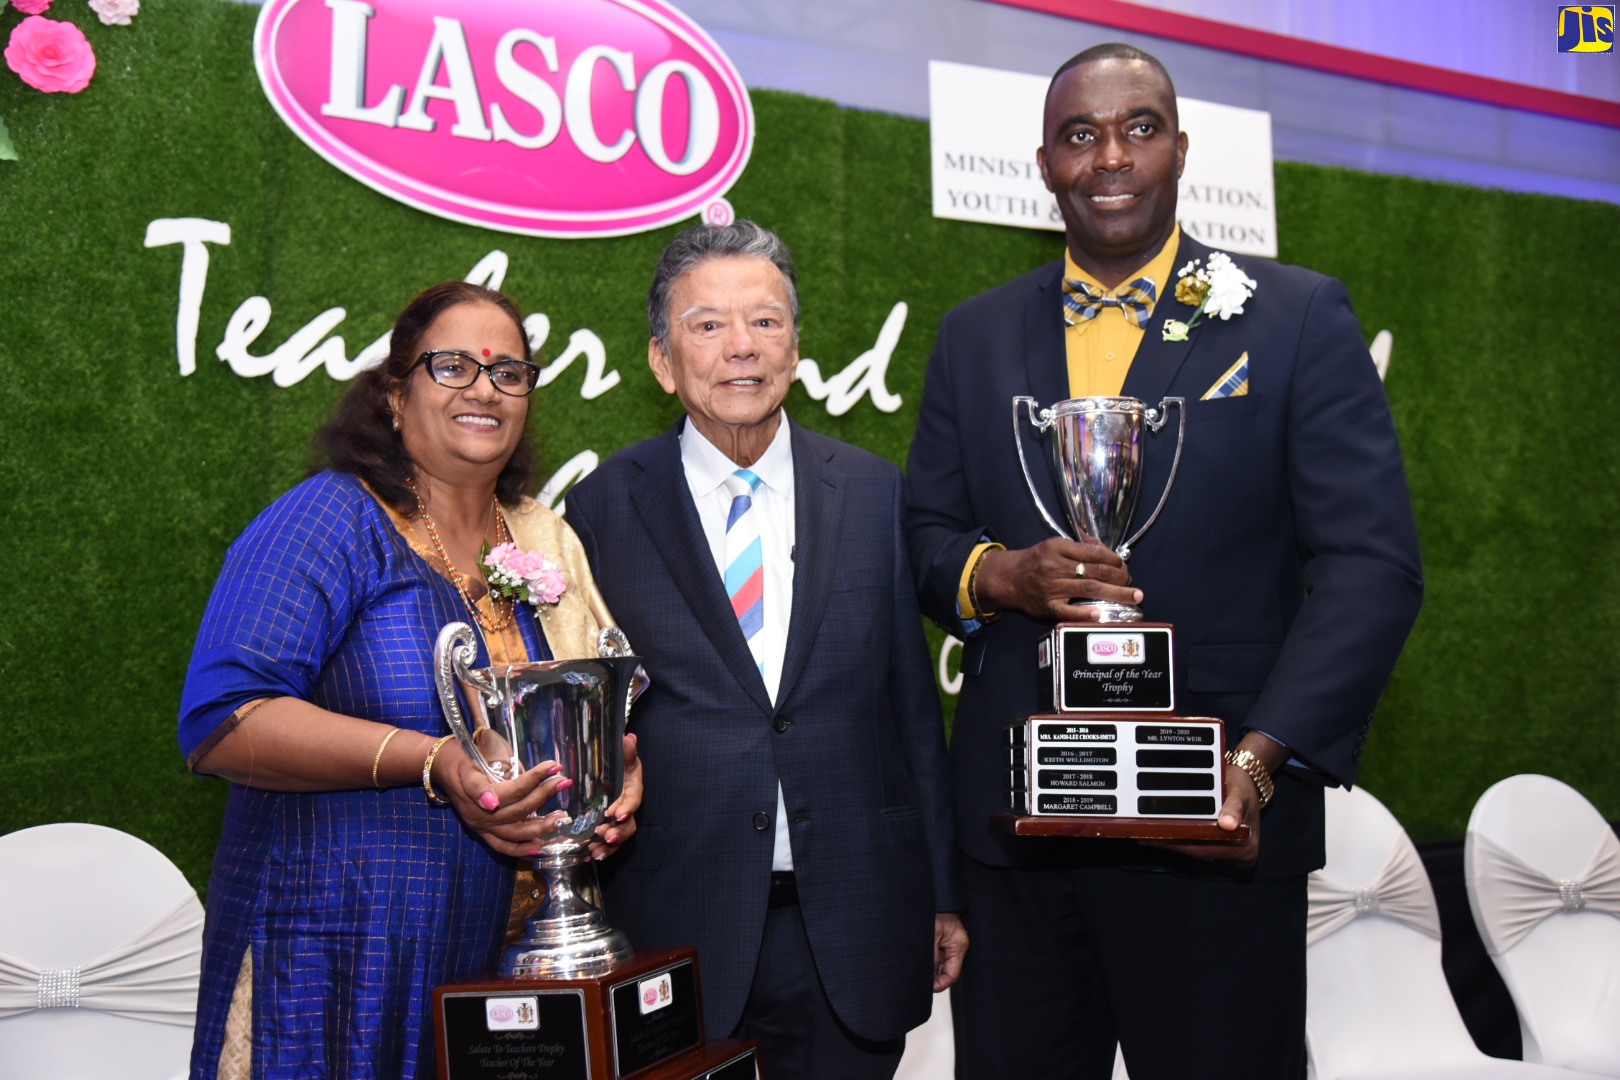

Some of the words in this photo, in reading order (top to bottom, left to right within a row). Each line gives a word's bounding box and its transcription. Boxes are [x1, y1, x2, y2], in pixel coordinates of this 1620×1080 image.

[321, 0, 720, 176] LASCO
[944, 152, 1041, 181] MINIST
[948, 189, 1038, 217] YOUTH
[1187, 220, 1265, 244] ATION
[144, 217, 620, 399] Teaer
[1094, 644, 1117, 653] LASCO
[1072, 669, 1112, 681] Principal
[1114, 668, 1126, 681] of
[1126, 669, 1139, 678] the
[1141, 669, 1162, 679] Year
[1102, 682, 1133, 694] Trophy
[468, 1044, 492, 1055] Salute
[493, 1044, 504, 1053] To
[504, 1042, 536, 1053] Teachers
[538, 1042, 565, 1056] Trophy
[479, 1057, 509, 1068] Teacher
[510, 1057, 520, 1070] Of
[520, 1057, 535, 1067] The
[537, 1057, 555, 1067] Year
